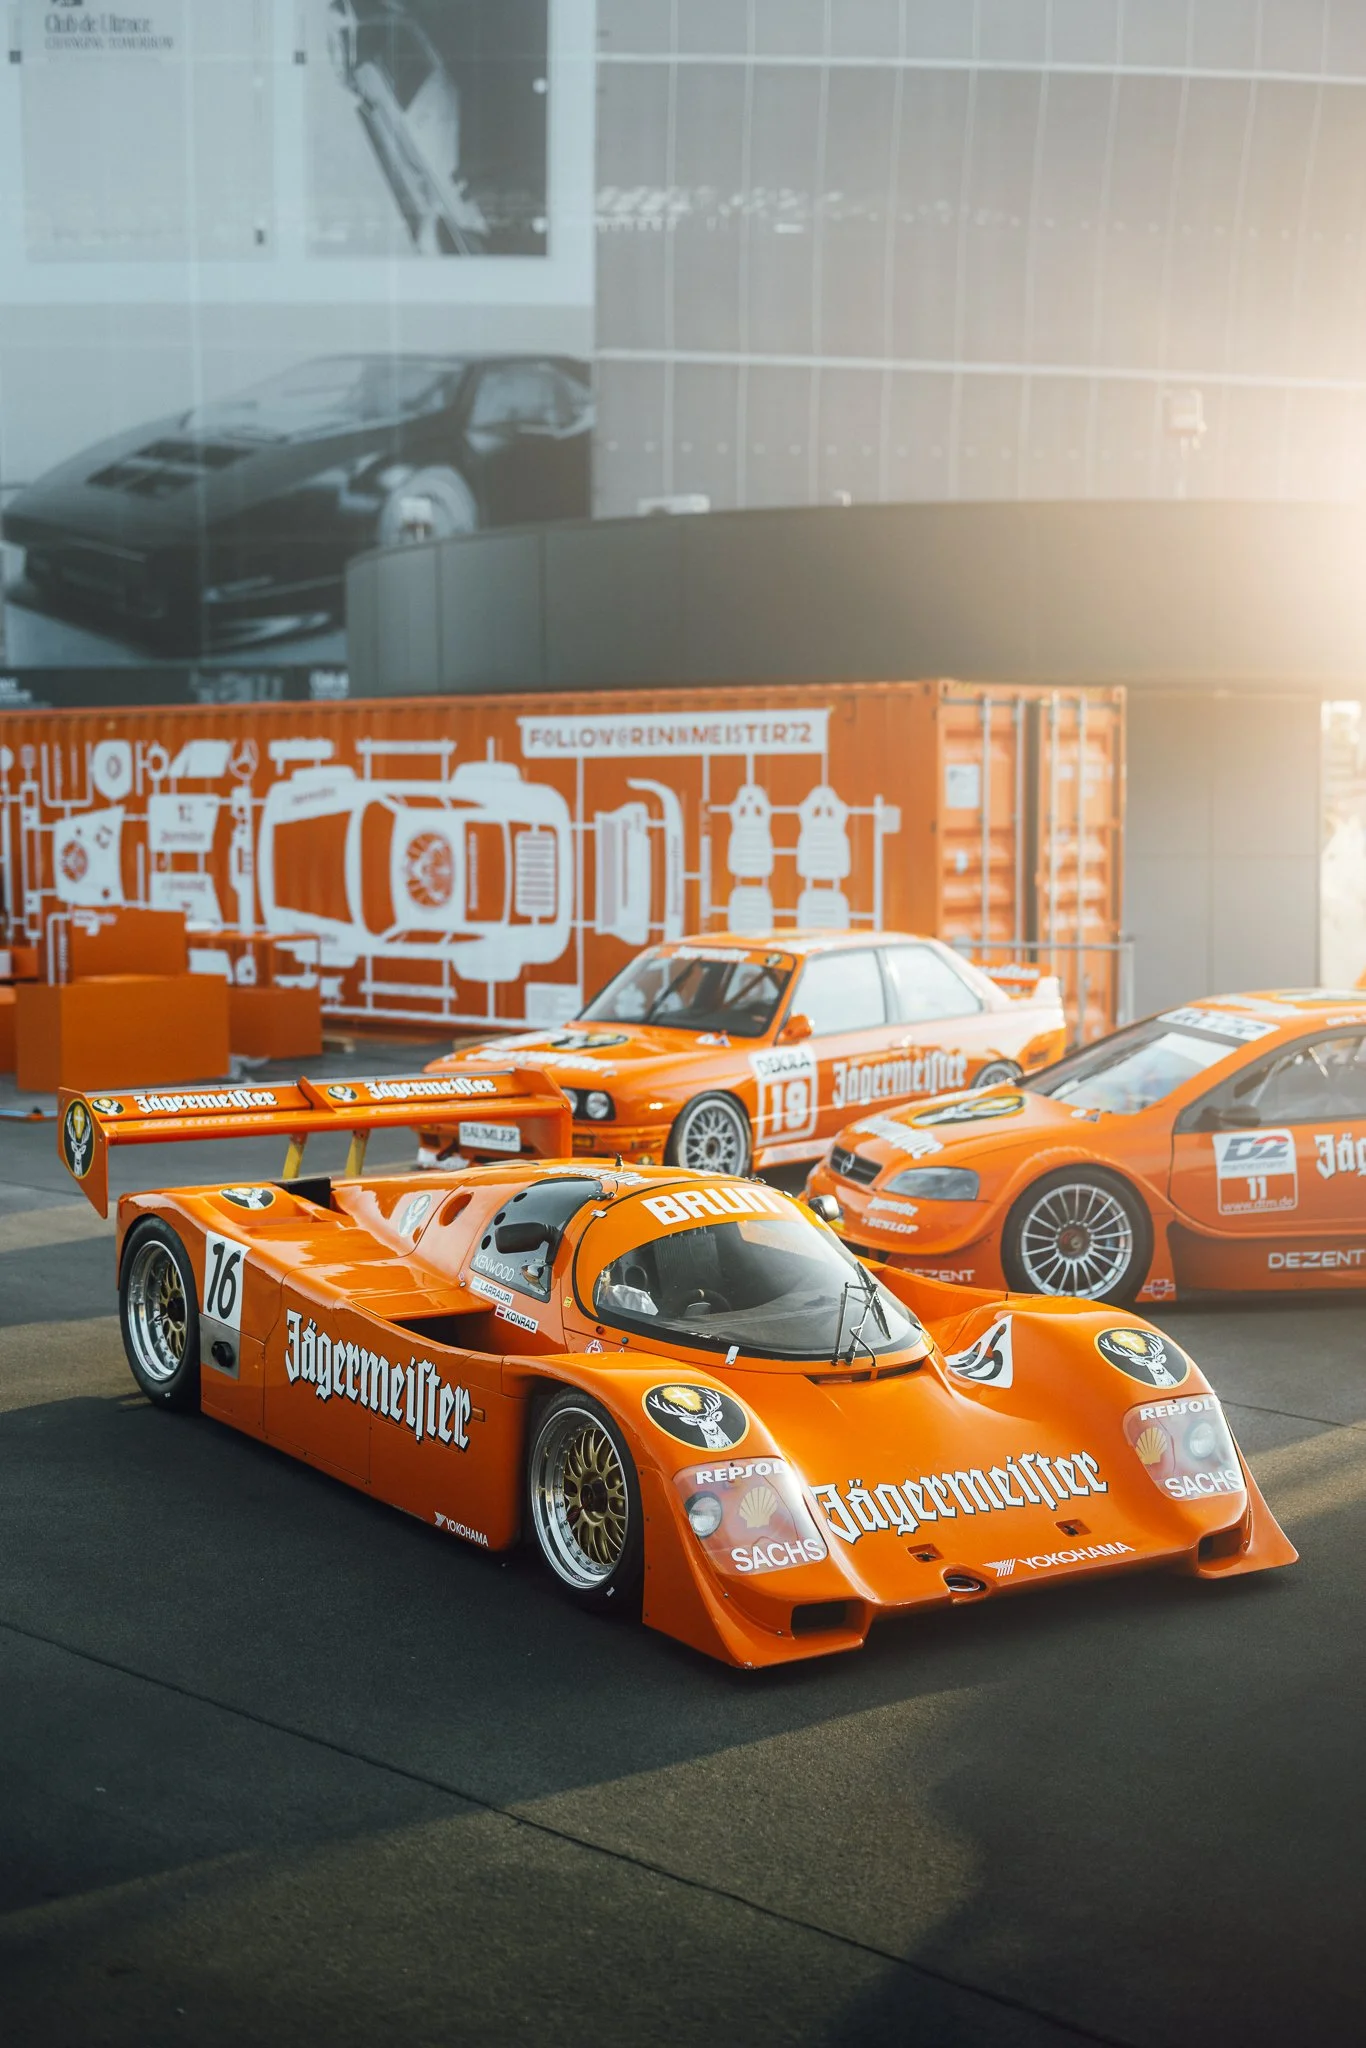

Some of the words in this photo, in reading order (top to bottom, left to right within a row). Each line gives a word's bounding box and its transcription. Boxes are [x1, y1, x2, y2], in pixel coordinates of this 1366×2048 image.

[756, 1052, 811, 1077] DEKRA
[134, 1089, 278, 1114] Jägermeister
[364, 1077, 497, 1100] Jägermeister
[1223, 1136, 1288, 1162] D2
[1247, 1176, 1267, 1200] 11
[640, 1188, 782, 1225] BRUN
[473, 1254, 515, 1283] KENWOOD
[1268, 1249, 1366, 1268] DEZENT
[207, 1241, 241, 1319] 16
[479, 1282, 513, 1302] LARRAURI
[505, 1310, 537, 1331] KONRAD
[284, 1308, 471, 1452] Jägermeister
[1139, 1400, 1214, 1421] REPSOL
[695, 1462, 786, 1485] REPSOL
[1164, 1470, 1242, 1499] SACHS
[810, 1450, 1109, 1545] Jägermeister
[445, 1517, 489, 1547] YOKOHAMA
[731, 1539, 826, 1572] SACHS
[1017, 1541, 1135, 1570] YOKOHAMA
